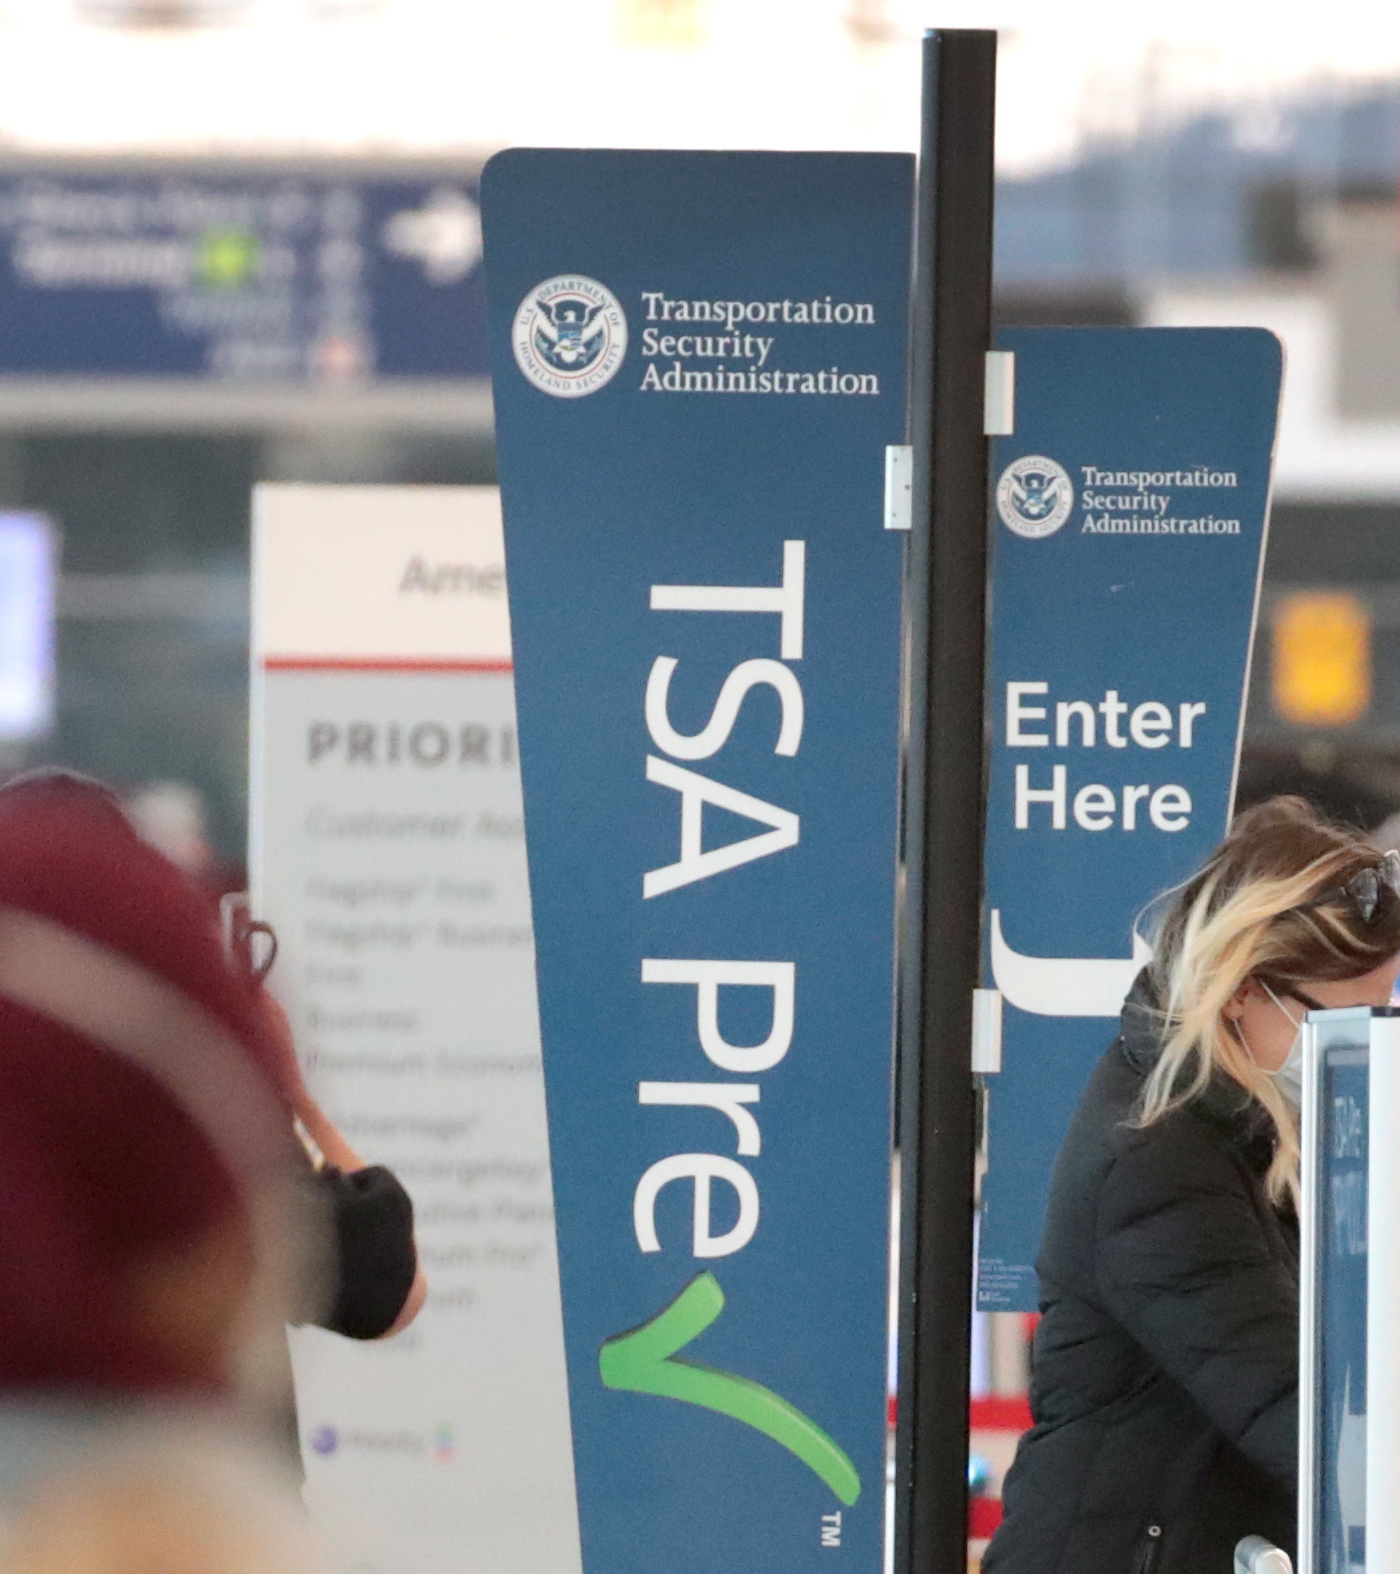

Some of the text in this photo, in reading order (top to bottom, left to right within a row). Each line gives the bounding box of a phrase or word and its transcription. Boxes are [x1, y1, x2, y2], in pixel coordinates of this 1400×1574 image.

[537, 281, 613, 310] DEPARTMENT
[641, 292, 876, 330] Transportation
[519, 339, 621, 391] HOMELAND SECURITY
[642, 328, 774, 367] Security
[640, 362, 880, 396] Administration
[1081, 466, 1238, 492] Transportation
[1081, 491, 1171, 516] Security
[1081, 513, 1241, 534] Administration
[643, 539, 806, 900] TSA
[1006, 681, 1206, 749] Enter
[1014, 764, 1193, 832] Here
[632, 958, 796, 1258] Pre
